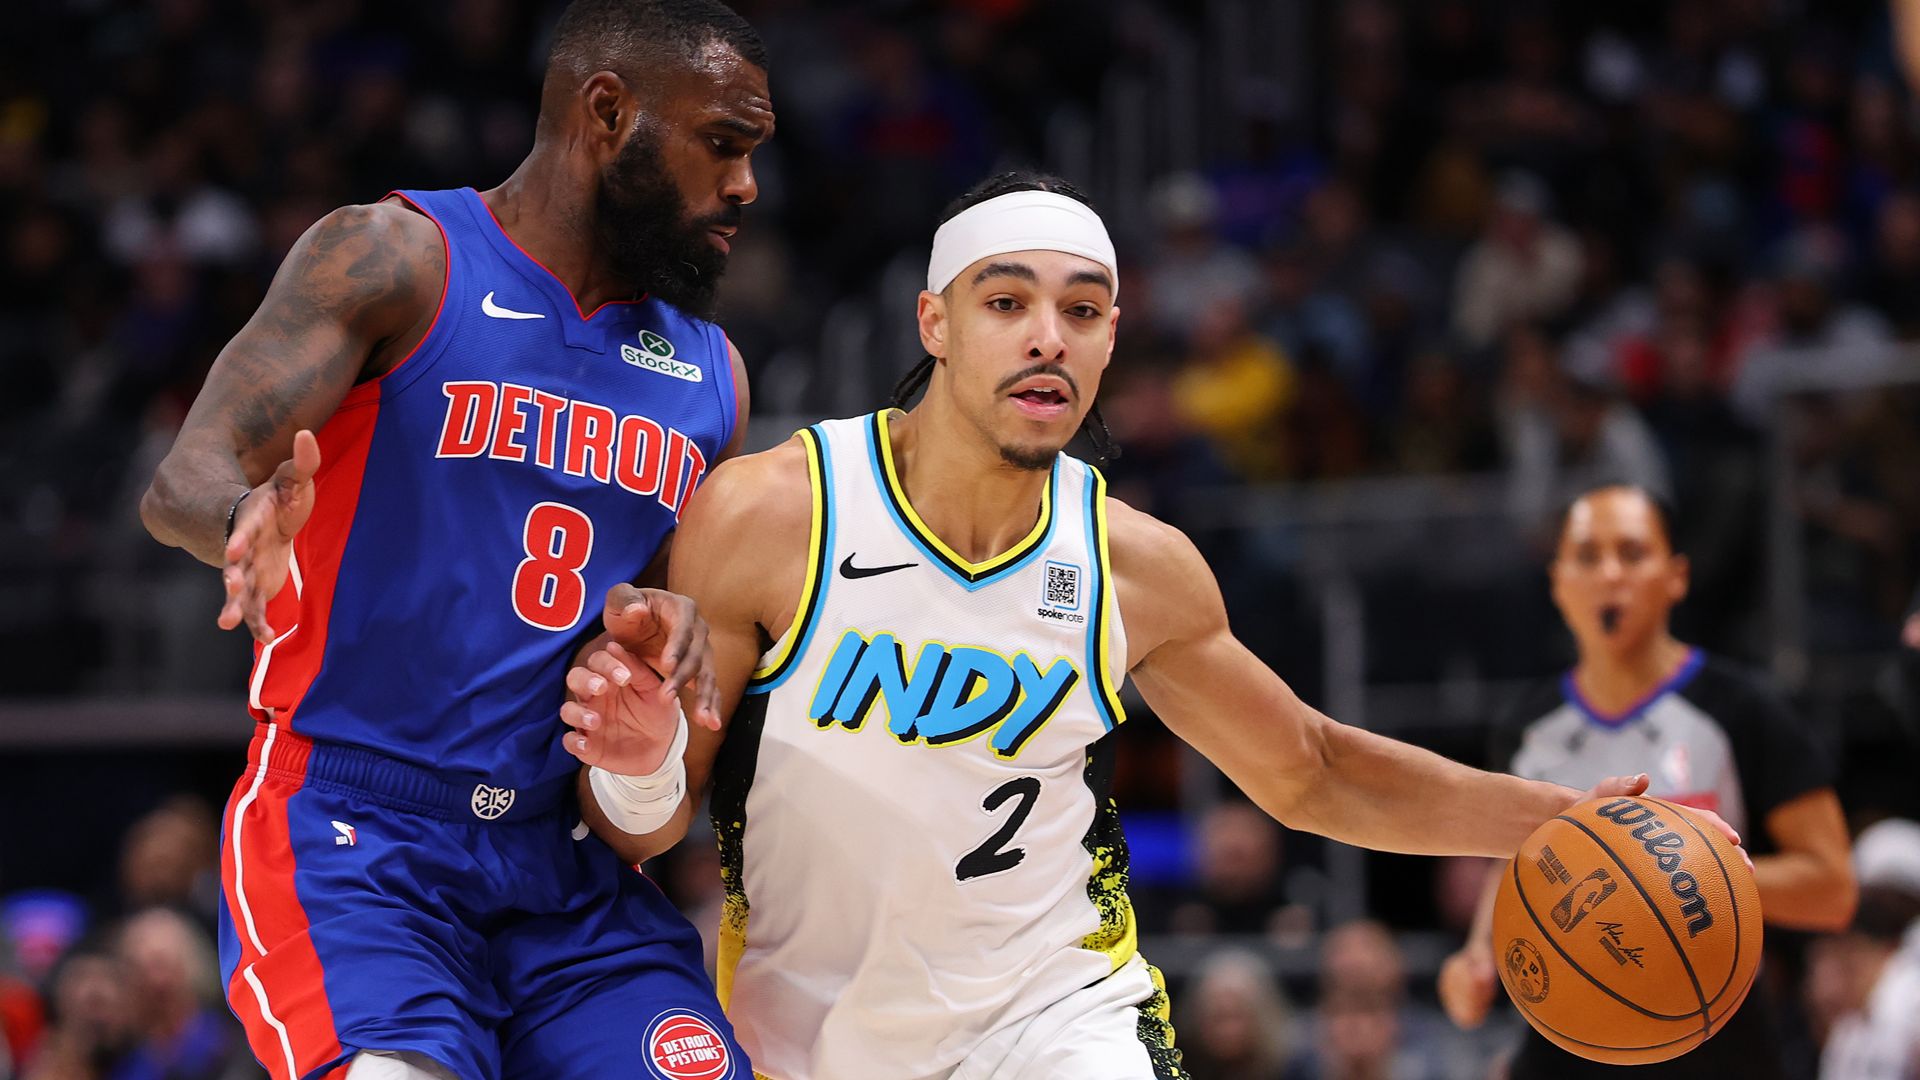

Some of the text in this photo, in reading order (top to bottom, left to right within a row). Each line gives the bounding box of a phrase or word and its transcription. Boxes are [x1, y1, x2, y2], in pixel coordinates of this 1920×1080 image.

[624, 348, 698, 379] StockX
[435, 381, 706, 524] DETROIT
[511, 501, 594, 632] 8
[1038, 608, 1084, 623] spokenote
[809, 627, 1080, 760] INDY
[955, 776, 1041, 881] 2
[1596, 799, 1713, 939] Wilson
[660, 1034, 713, 1055] DETROIT
[665, 1047, 720, 1068] PISTONS
